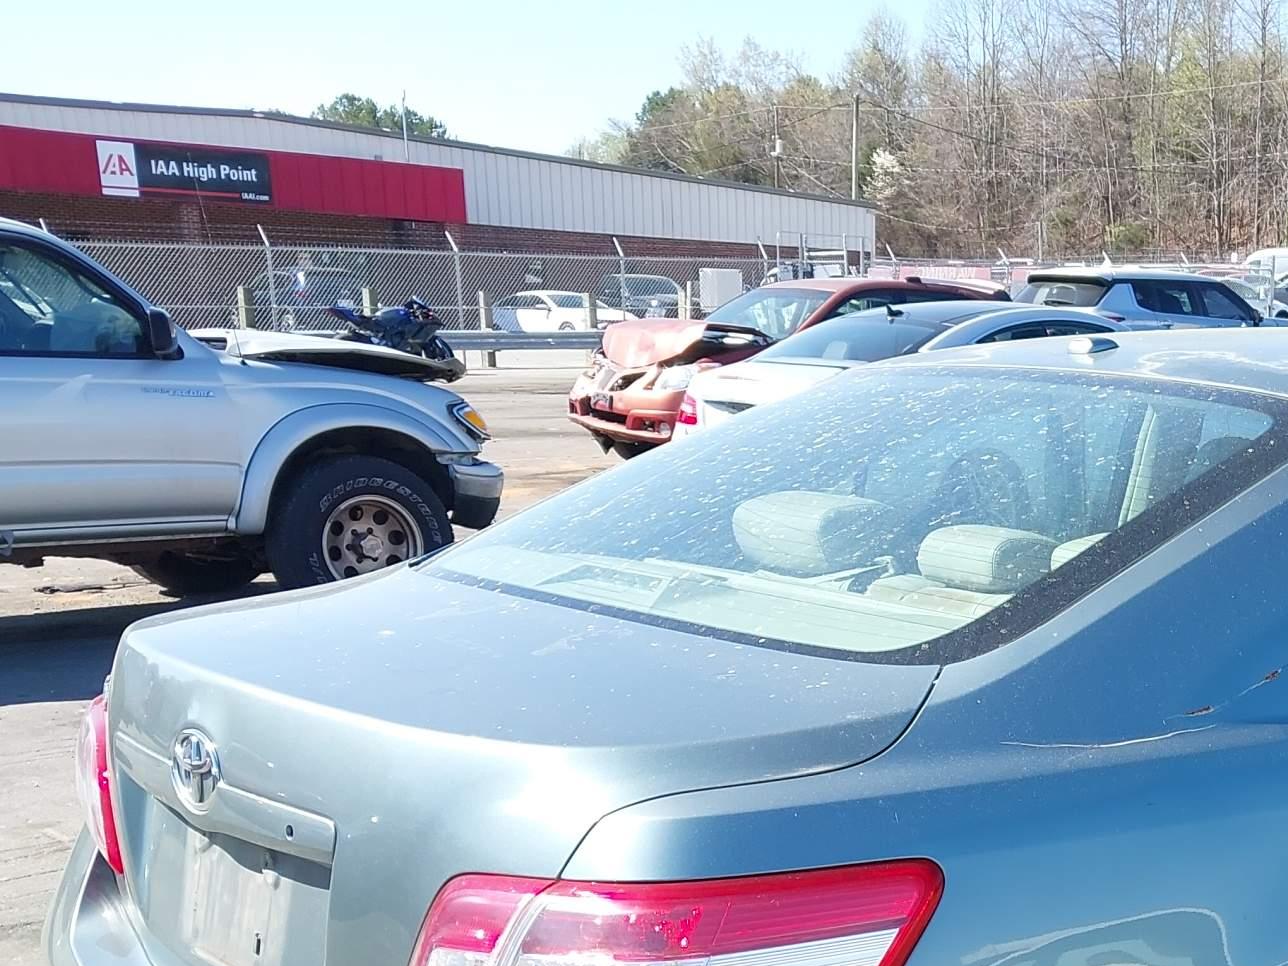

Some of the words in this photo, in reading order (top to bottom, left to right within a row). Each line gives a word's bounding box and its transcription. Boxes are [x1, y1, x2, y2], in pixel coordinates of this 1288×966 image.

[151, 160, 180, 176] IAA
[183, 162, 217, 181] High
[220, 165, 258, 182] Point
